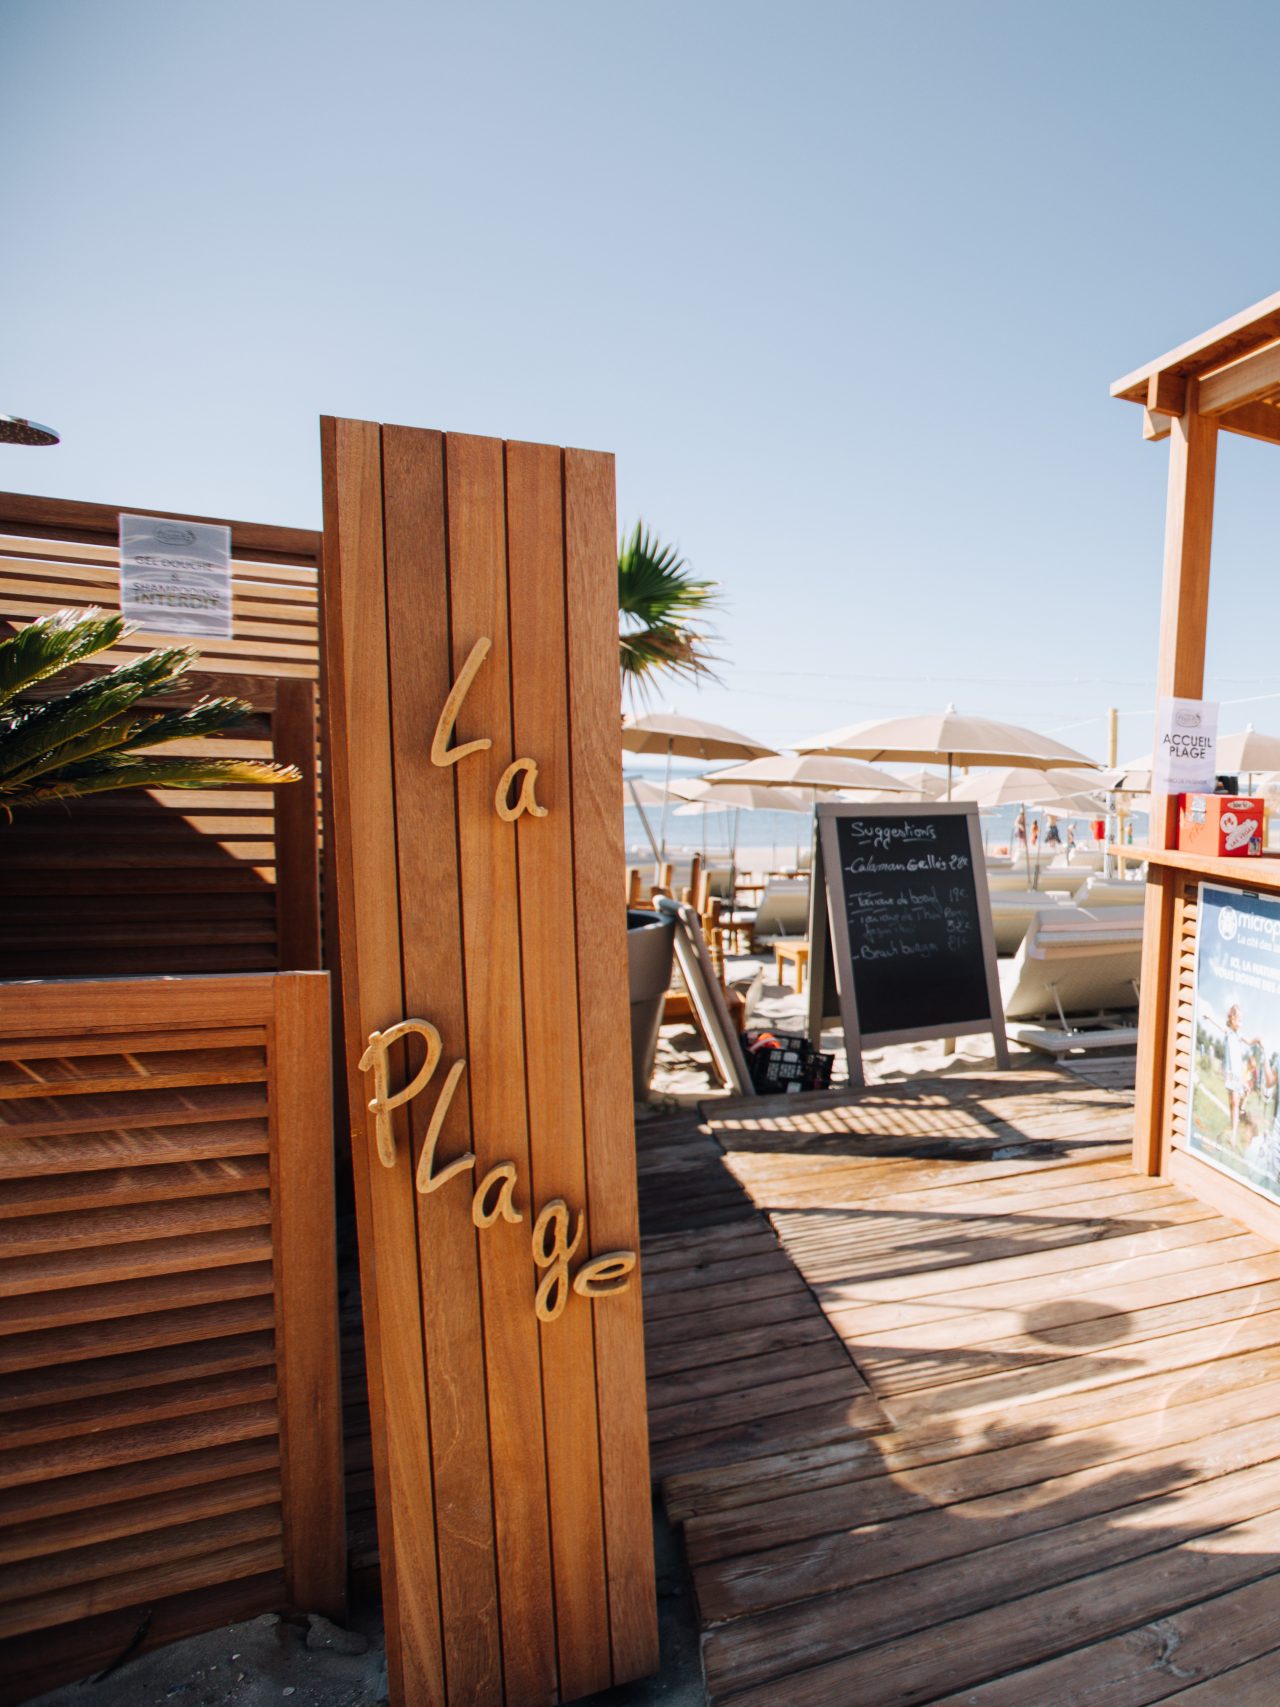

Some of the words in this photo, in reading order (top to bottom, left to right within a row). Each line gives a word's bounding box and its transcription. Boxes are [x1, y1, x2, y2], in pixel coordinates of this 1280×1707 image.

[134, 592, 219, 609] INTERDIT
[430, 637, 548, 822] La
[1163, 733, 1212, 748] ACCUEIL
[1169, 746, 1206, 759] PLAGE
[851, 821, 937, 850] Suggestions
